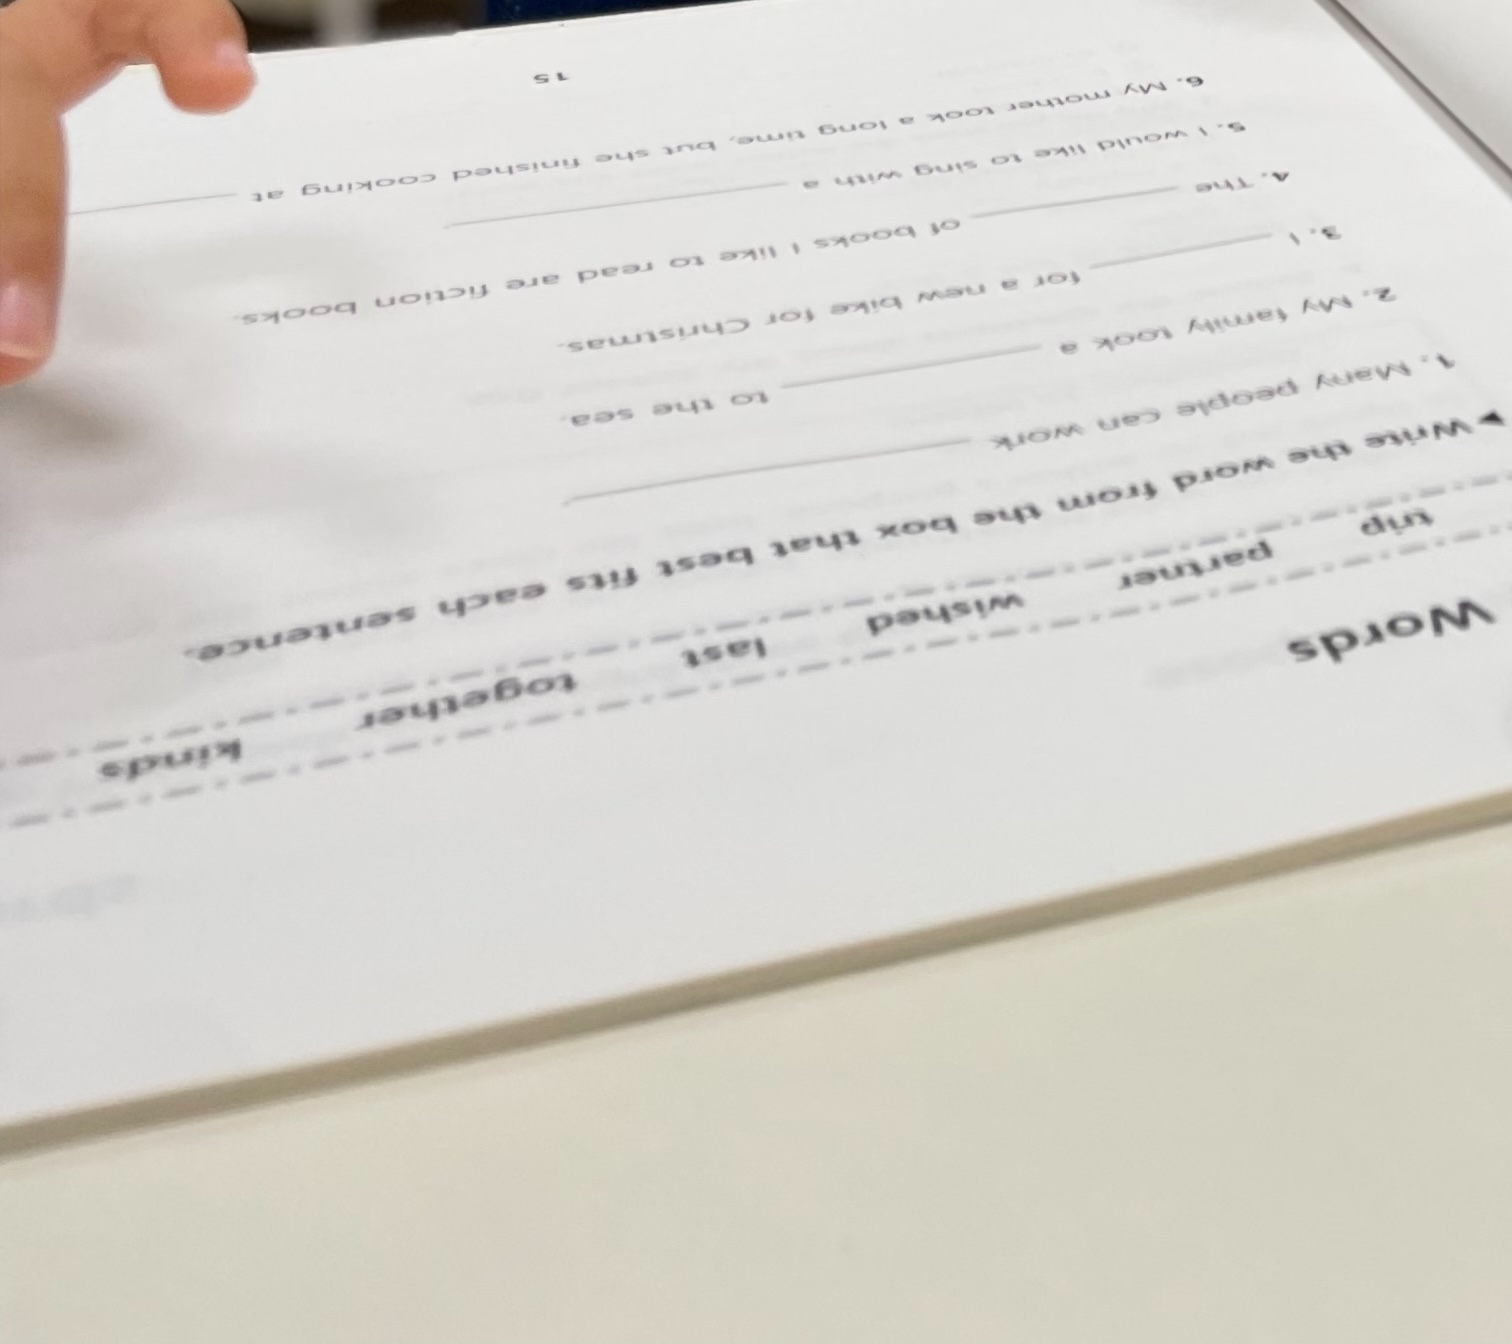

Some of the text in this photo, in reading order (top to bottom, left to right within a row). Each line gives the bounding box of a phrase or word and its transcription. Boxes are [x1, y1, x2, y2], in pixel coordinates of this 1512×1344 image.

[252, 76, 1204, 202] 6. My mother took a long time, but she finished cooking at
[533, 72, 570, 84] 15
[803, 122, 1246, 189] 5. I would like to sing with a
[236, 171, 1290, 325] 4. The of books I like to read are fiction books.
[560, 225, 1342, 352] 3. I for a new bike for Christmas.
[563, 286, 1397, 427] 2. My family took a to the sea.
[989, 353, 1456, 451] 1. Many people can work
[185, 415, 1475, 662] Write the word from the box that best fits each sentence.
[97, 508, 1434, 781] trip partner wished last together kinds
[1287, 598, 1498, 664] Words
